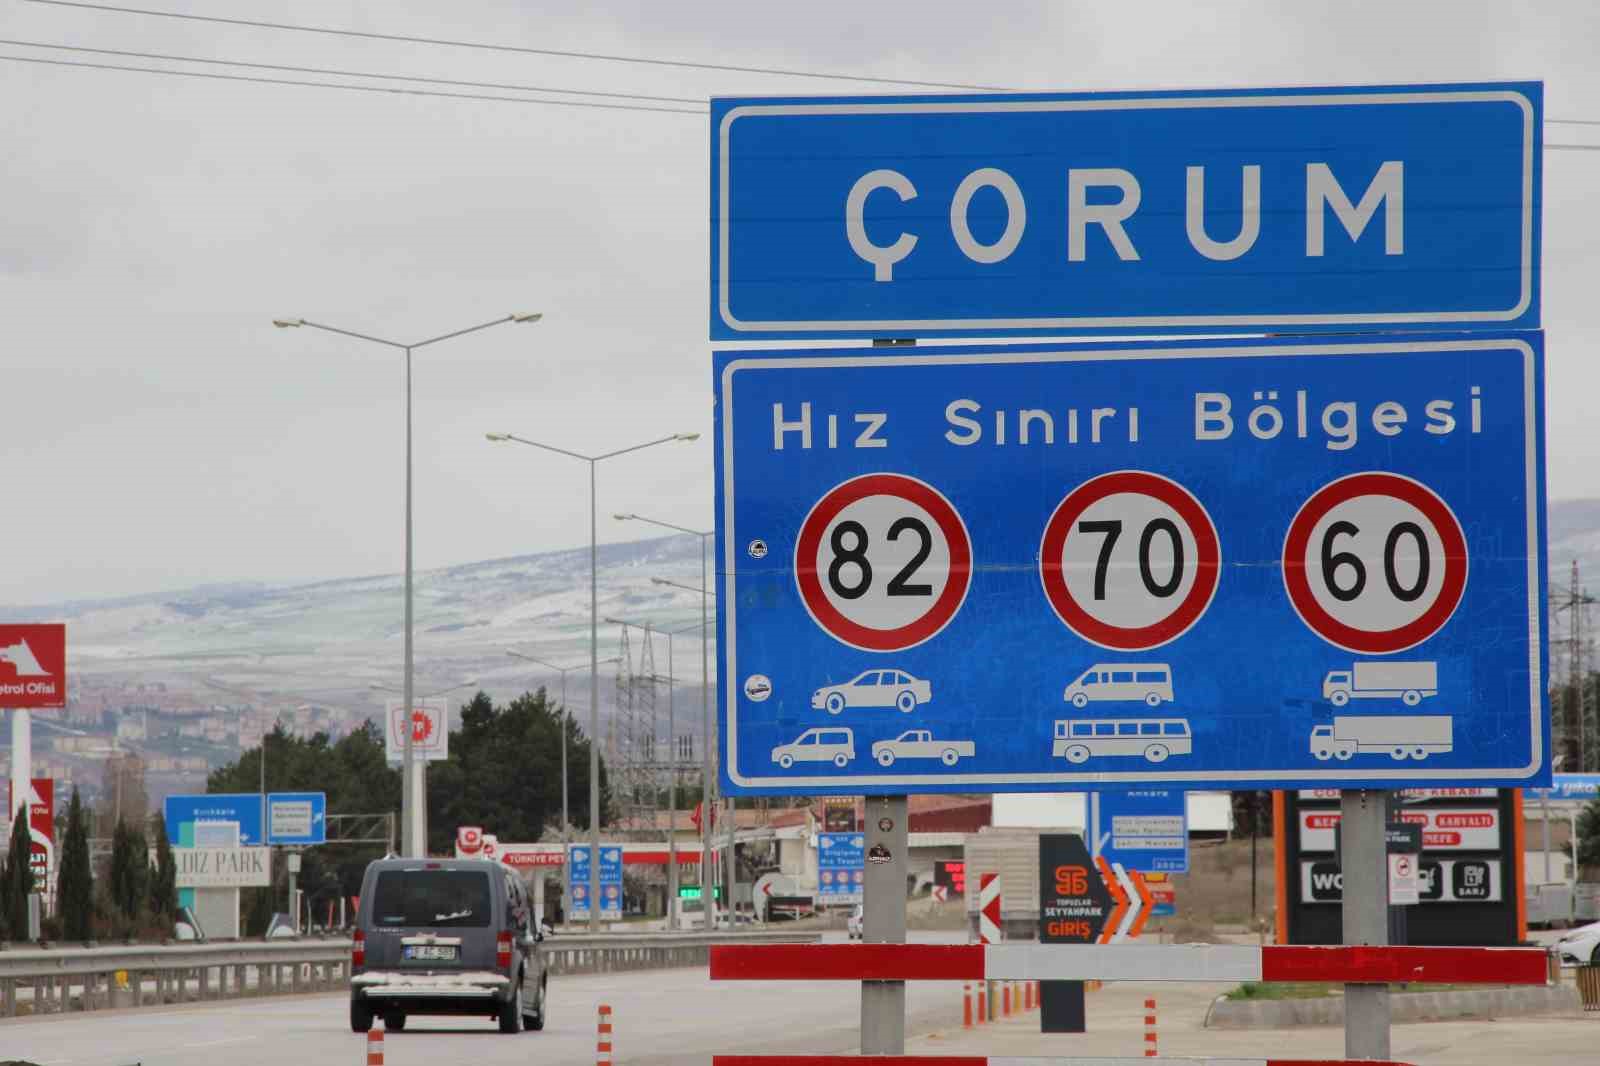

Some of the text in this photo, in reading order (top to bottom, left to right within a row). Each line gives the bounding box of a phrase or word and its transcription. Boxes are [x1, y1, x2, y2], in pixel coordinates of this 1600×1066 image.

[845, 160, 1404, 282] ÇORUM
[773, 386, 1482, 451] Hız Sınırı Bölgesi
[828, 516, 933, 600] 82
[1078, 517, 1185, 601] 70
[1320, 520, 1431, 602] 60
[27, 681, 56, 695] Ofisi
[215, 851, 264, 873] PARK
[1312, 873, 1343, 890] WC
[1044, 907, 1103, 917] SEYYAHPARK
[1047, 919, 1092, 940] GİRİŞ
